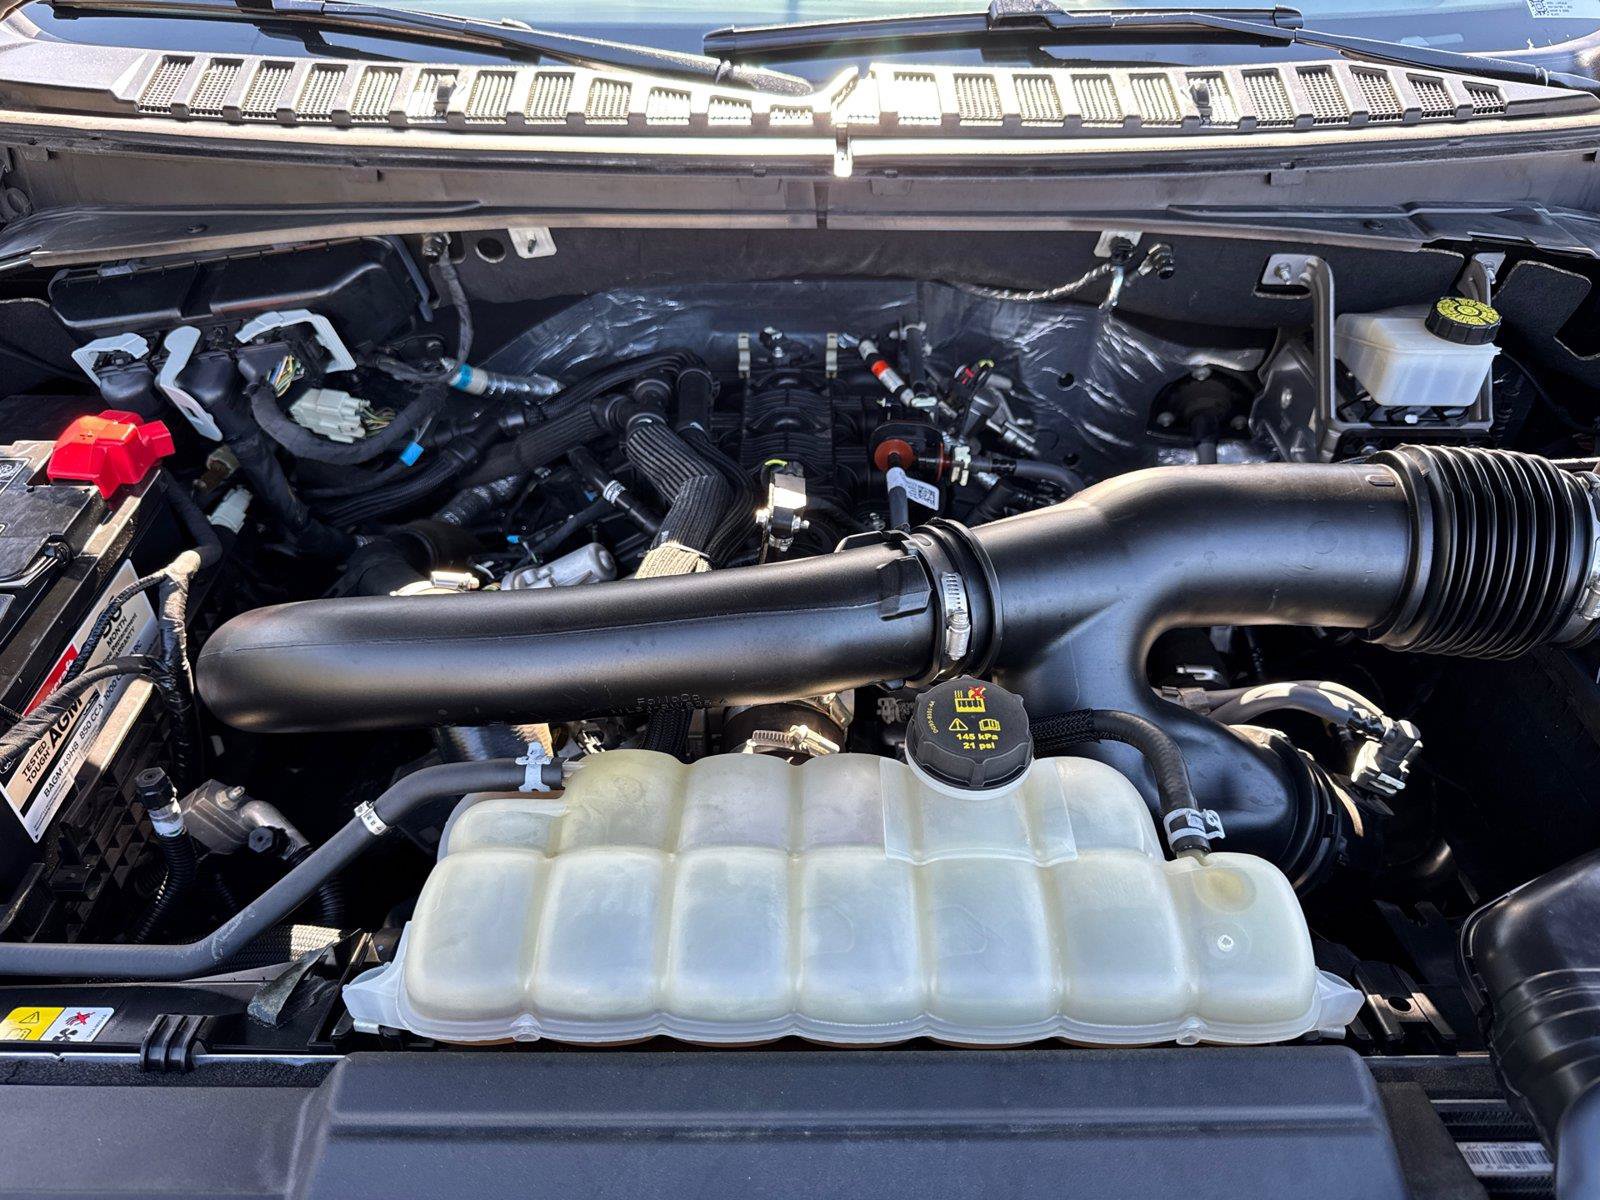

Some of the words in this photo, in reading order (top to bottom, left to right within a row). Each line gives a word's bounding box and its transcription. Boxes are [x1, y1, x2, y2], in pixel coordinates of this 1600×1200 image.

[107, 615, 127, 647] MONTH
[43, 741, 79, 798] BAGM-49H8
[80, 720, 92, 739] 850
[90, 703, 104, 721] CCA
[103, 680, 117, 701] 1000
[49, 697, 83, 749] AGM
[21, 740, 47, 777] TESTED
[962, 741, 976, 749] 21
[979, 741, 996, 750] psi
